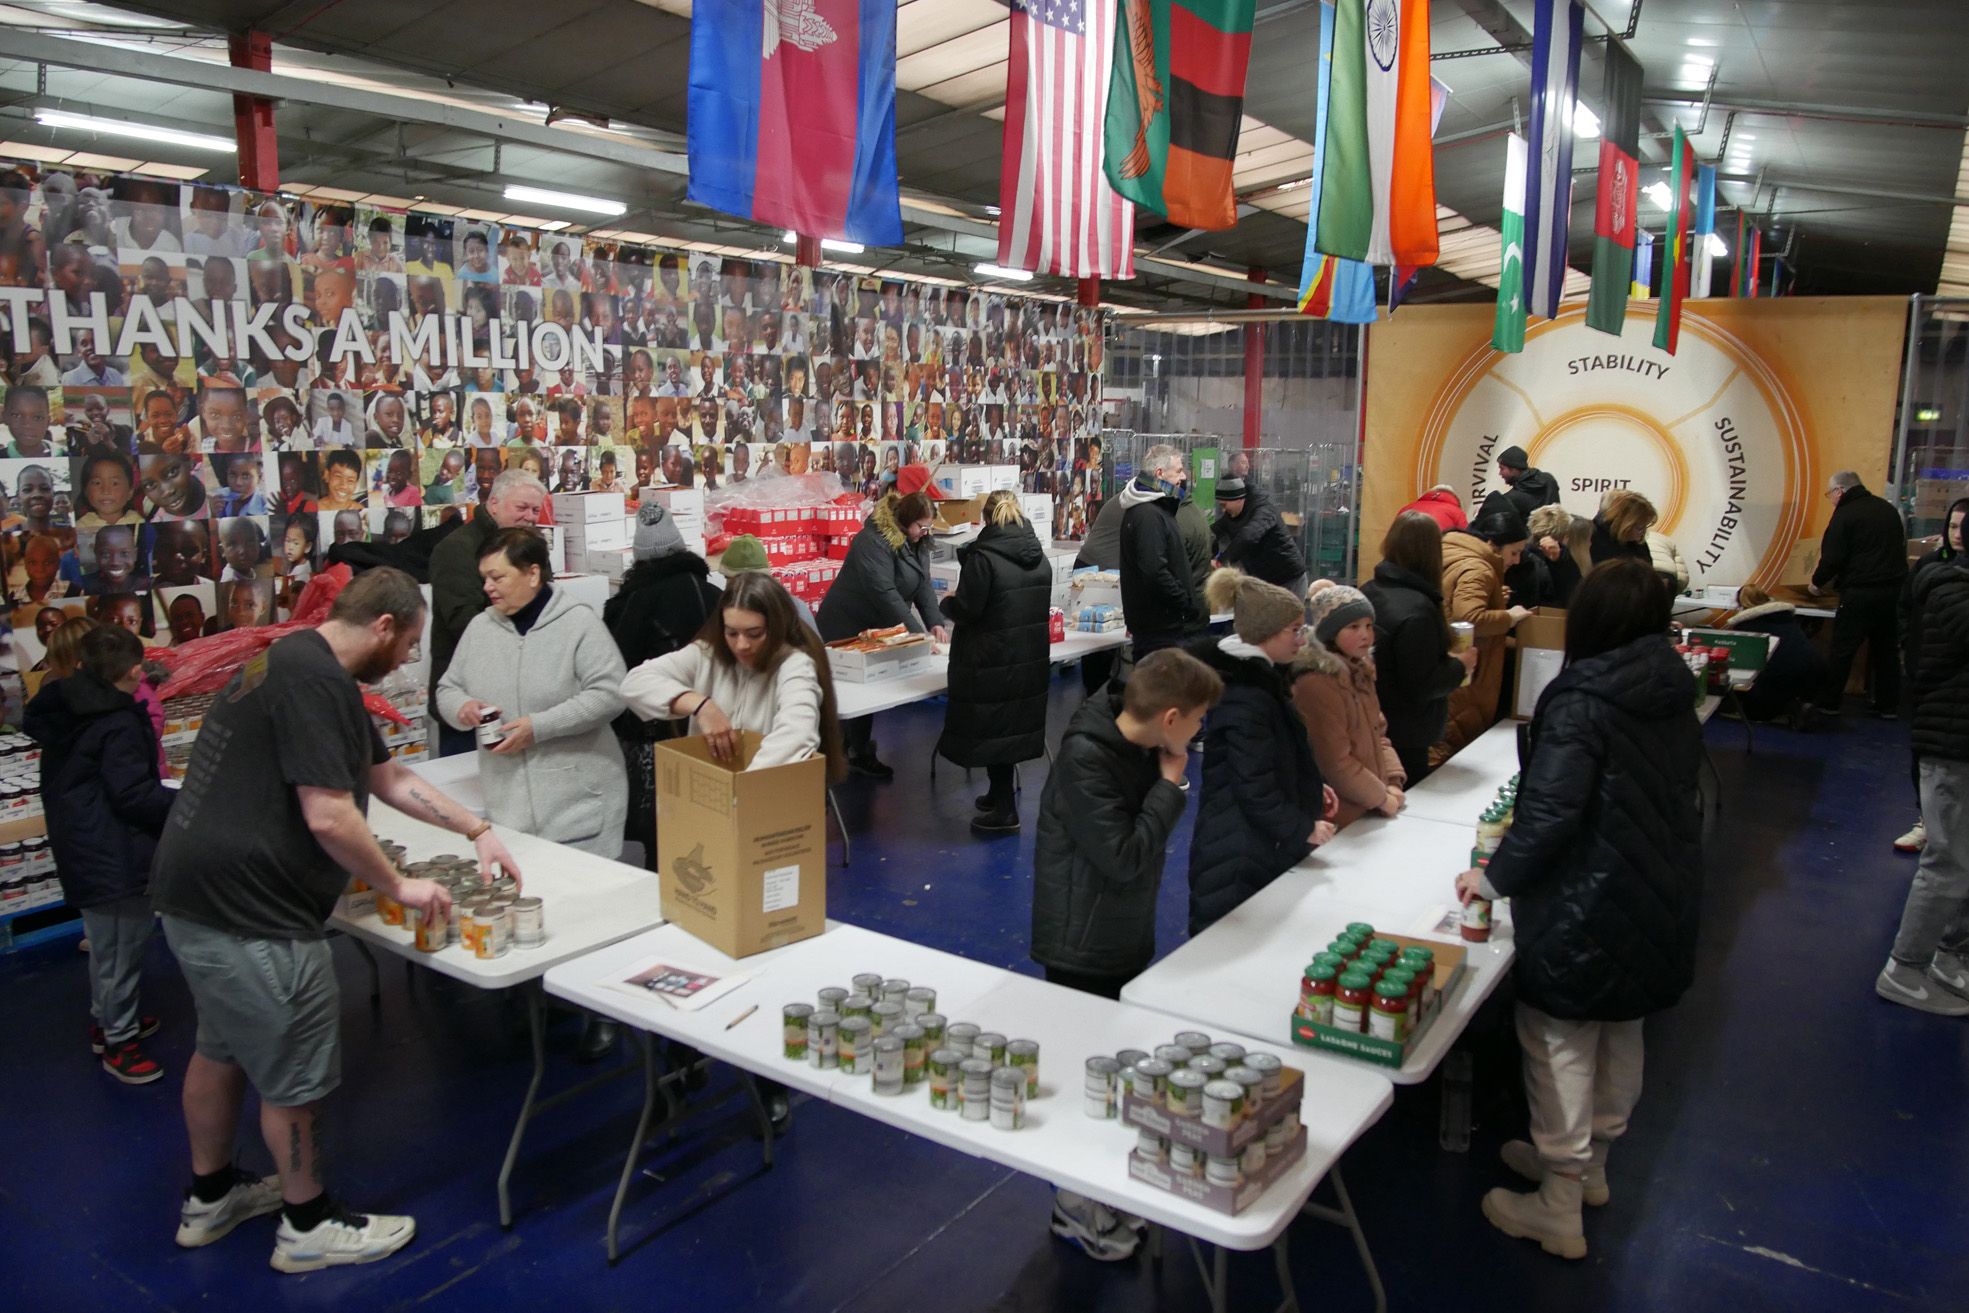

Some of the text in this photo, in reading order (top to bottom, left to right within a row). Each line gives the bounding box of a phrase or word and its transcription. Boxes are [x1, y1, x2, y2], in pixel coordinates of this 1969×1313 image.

[0, 286, 605, 373] THANKS A MILLION
[1567, 354, 1670, 381] STABILITY
[1471, 433, 1499, 506] RVIVAL
[1571, 477, 1631, 493] SPIRIT
[1696, 417, 1748, 575] SUSTAINABILITY
